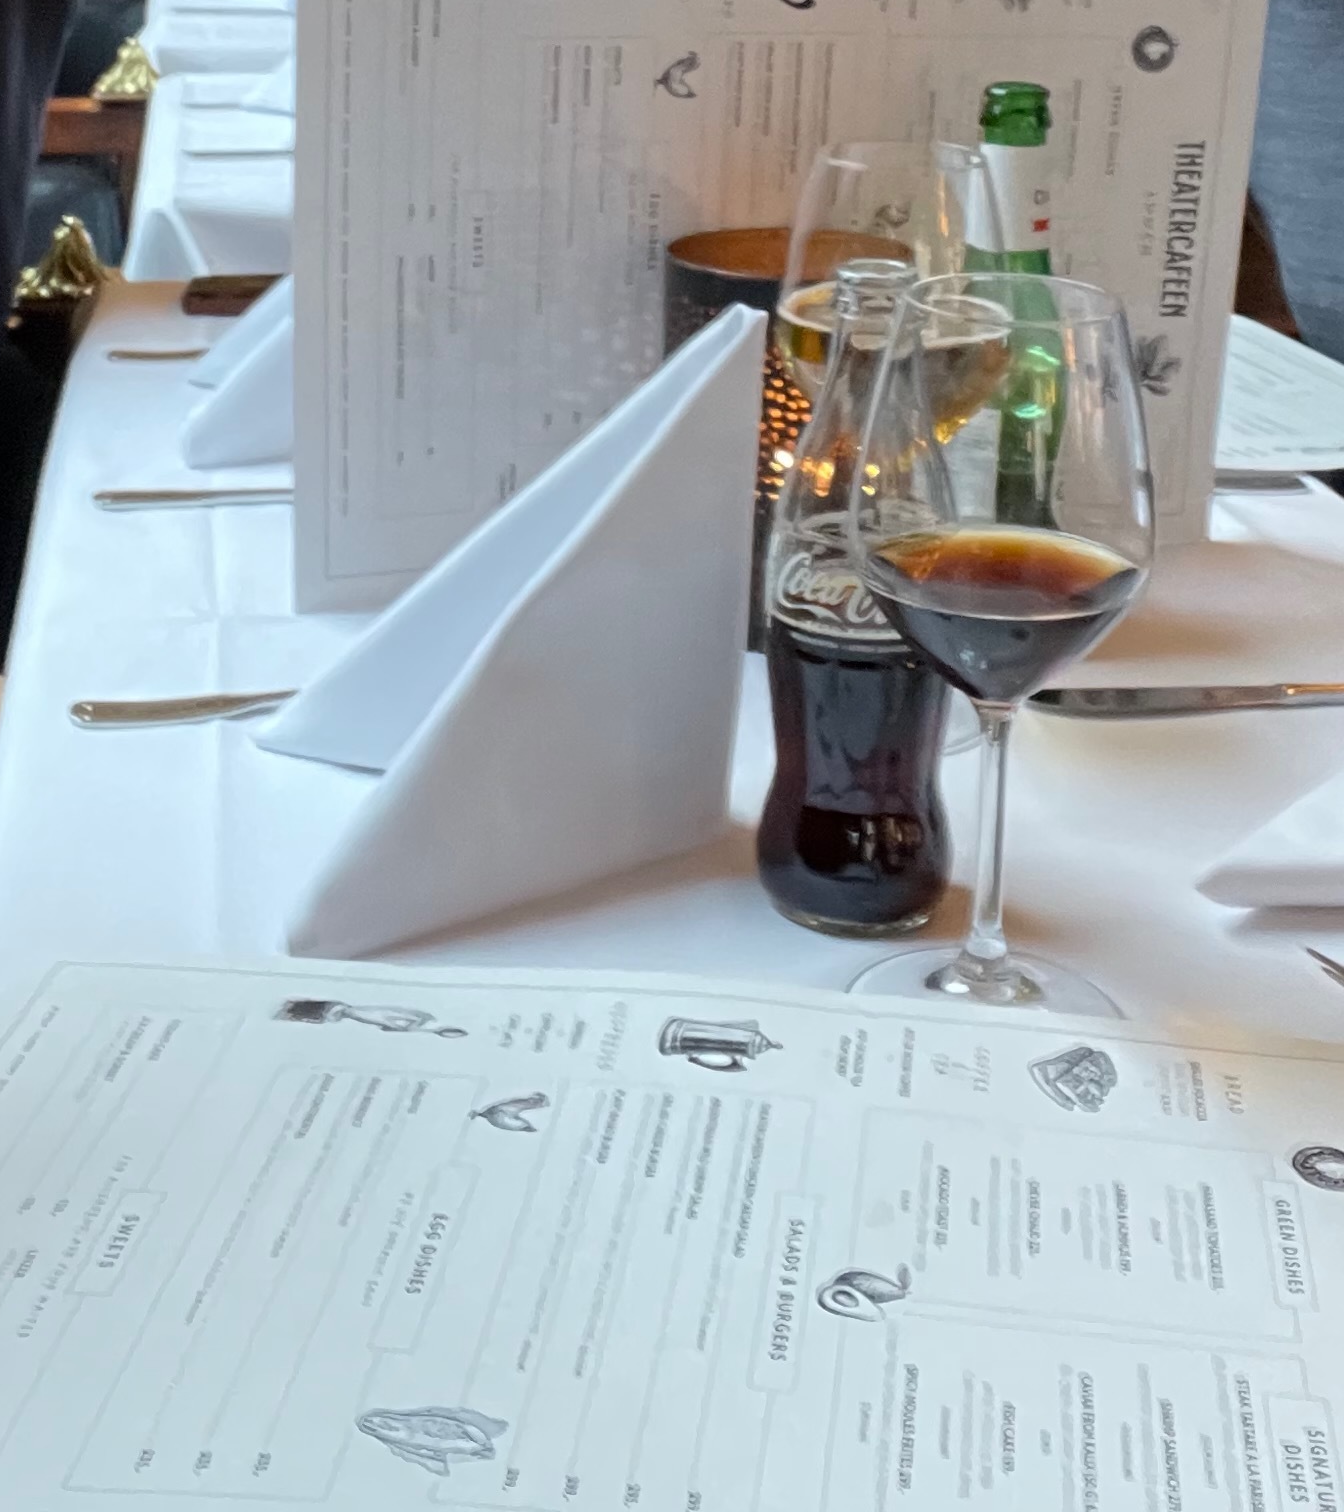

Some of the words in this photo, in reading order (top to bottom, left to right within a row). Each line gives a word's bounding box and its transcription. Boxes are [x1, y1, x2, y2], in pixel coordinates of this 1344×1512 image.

[1161, 143, 1204, 317] THEATERCAFEEN
[98, 1215, 139, 1267] SWEETS
[424, 1213, 448, 1239] EGG
[1274, 1199, 1294, 1241] GREEN
[405, 1244, 436, 1293] DISHES
[782, 1219, 804, 1271] SALADS
[1281, 1246, 1304, 1293] DISHES
[779, 1276, 797, 1285] &
[769, 1292, 794, 1360] BURGERS
[1235, 1379, 1250, 1407] STEAK
[1283, 1444, 1309, 1502] DISHES
